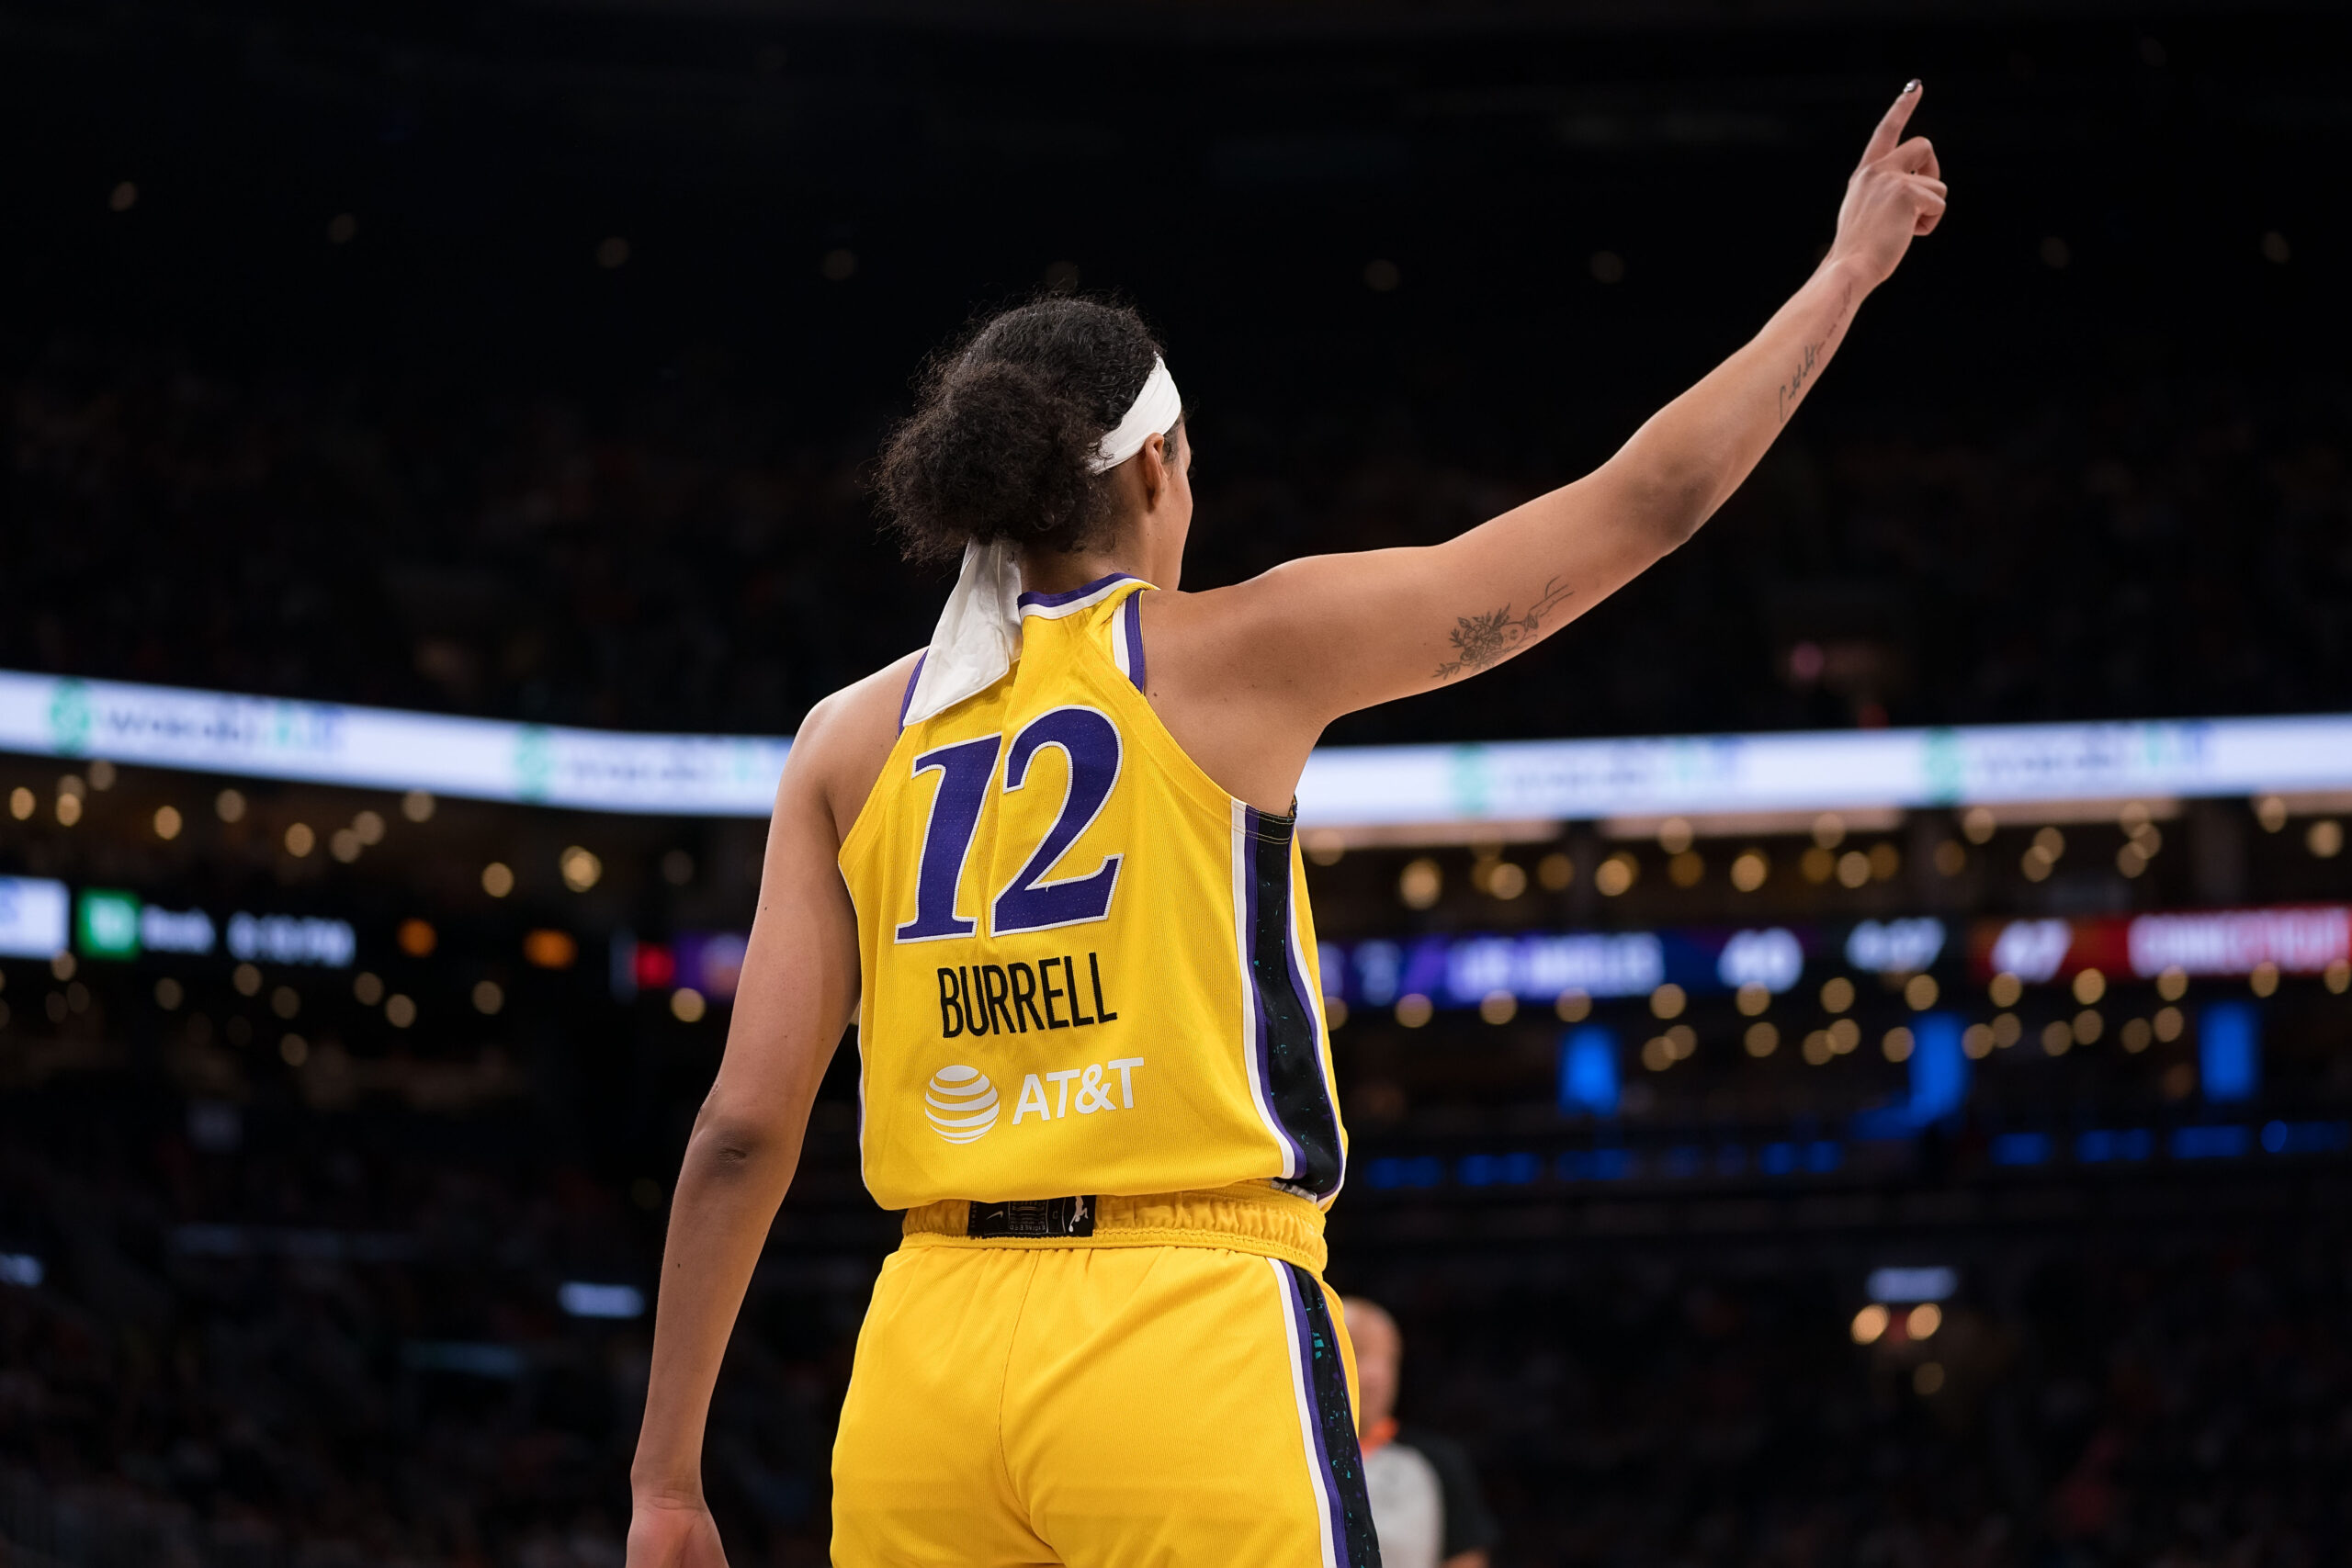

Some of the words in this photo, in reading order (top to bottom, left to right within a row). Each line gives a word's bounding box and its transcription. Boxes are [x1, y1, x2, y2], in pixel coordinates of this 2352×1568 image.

[894, 705, 1125, 944] 12
[937, 952, 1118, 1038] BURRELL
[1012, 1057, 1144, 1125] AT&T
